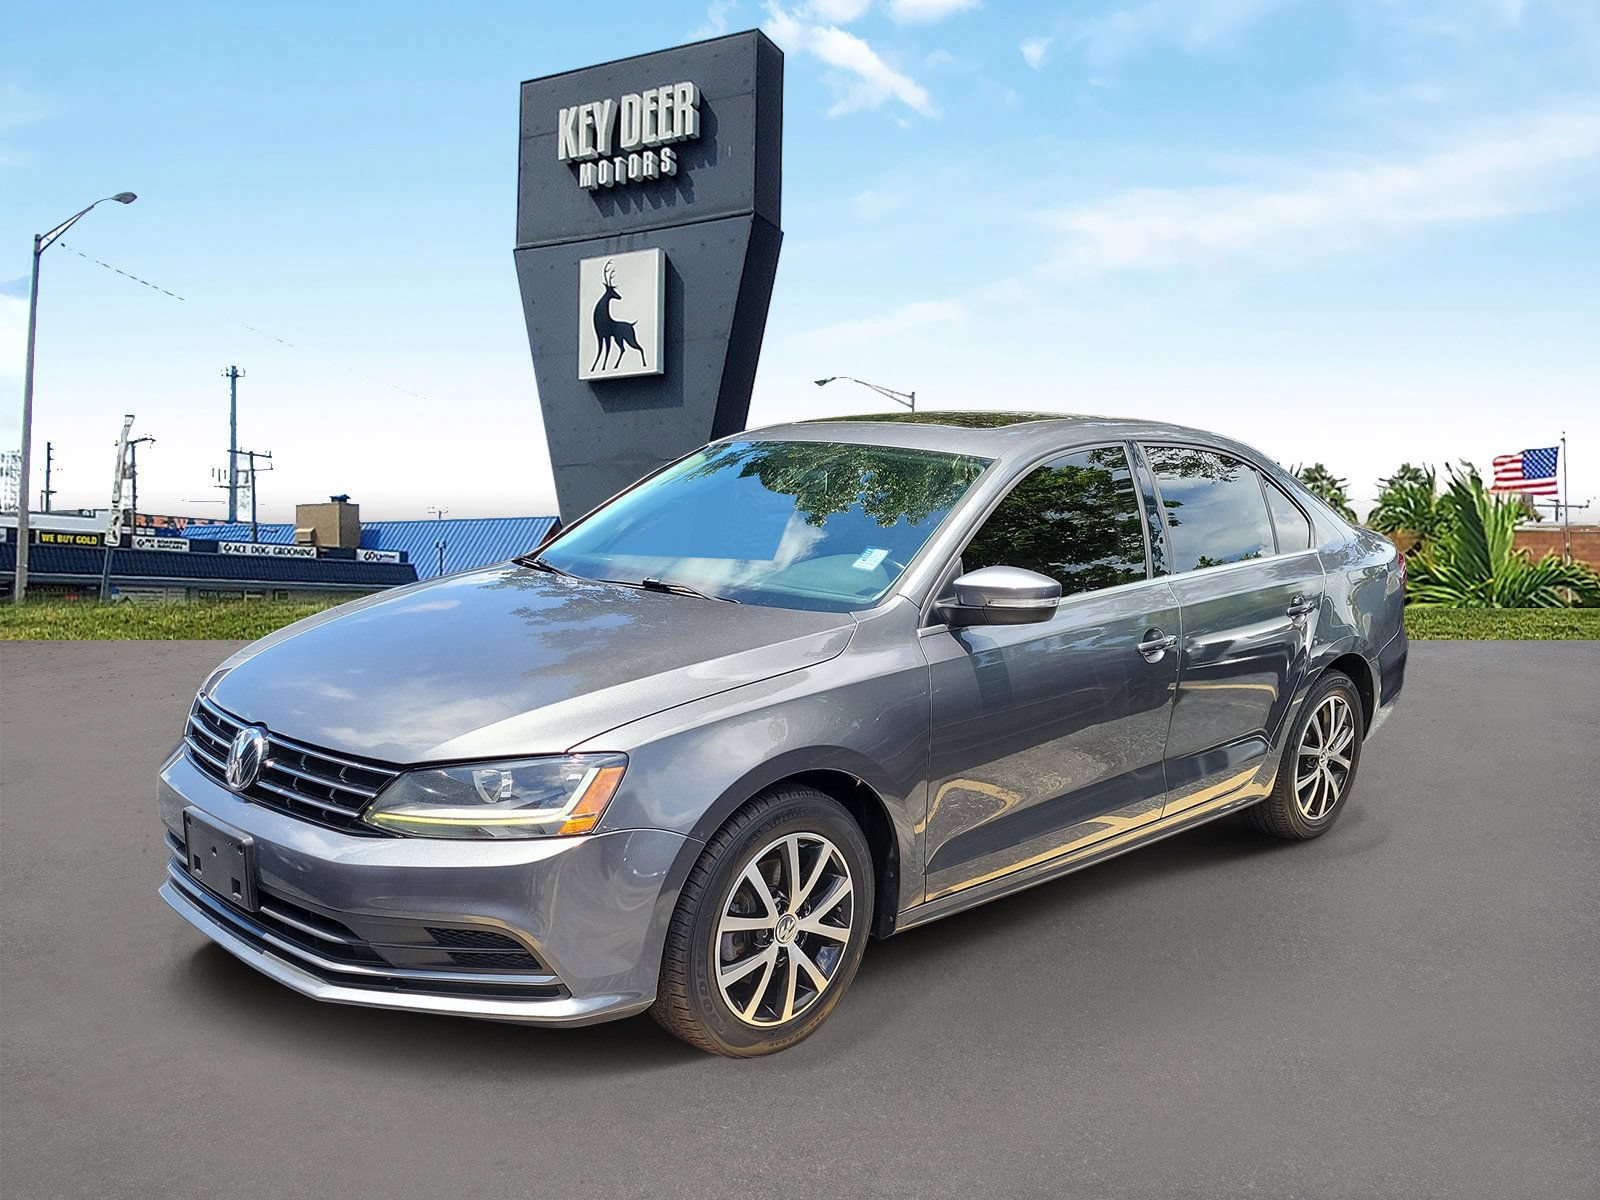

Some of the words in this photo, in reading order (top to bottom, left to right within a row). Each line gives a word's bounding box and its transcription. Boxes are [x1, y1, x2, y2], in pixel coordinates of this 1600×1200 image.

[558, 98, 617, 163] KEY
[620, 81, 700, 151] DEER
[579, 147, 677, 190] MOTORS
[41, 533, 55, 543] WE
[57, 534, 75, 544] BUY
[76, 535, 97, 545] GOLD
[233, 545, 247, 554] ACE
[251, 546, 270, 556] DOG
[273, 547, 315, 558] GROOMING
